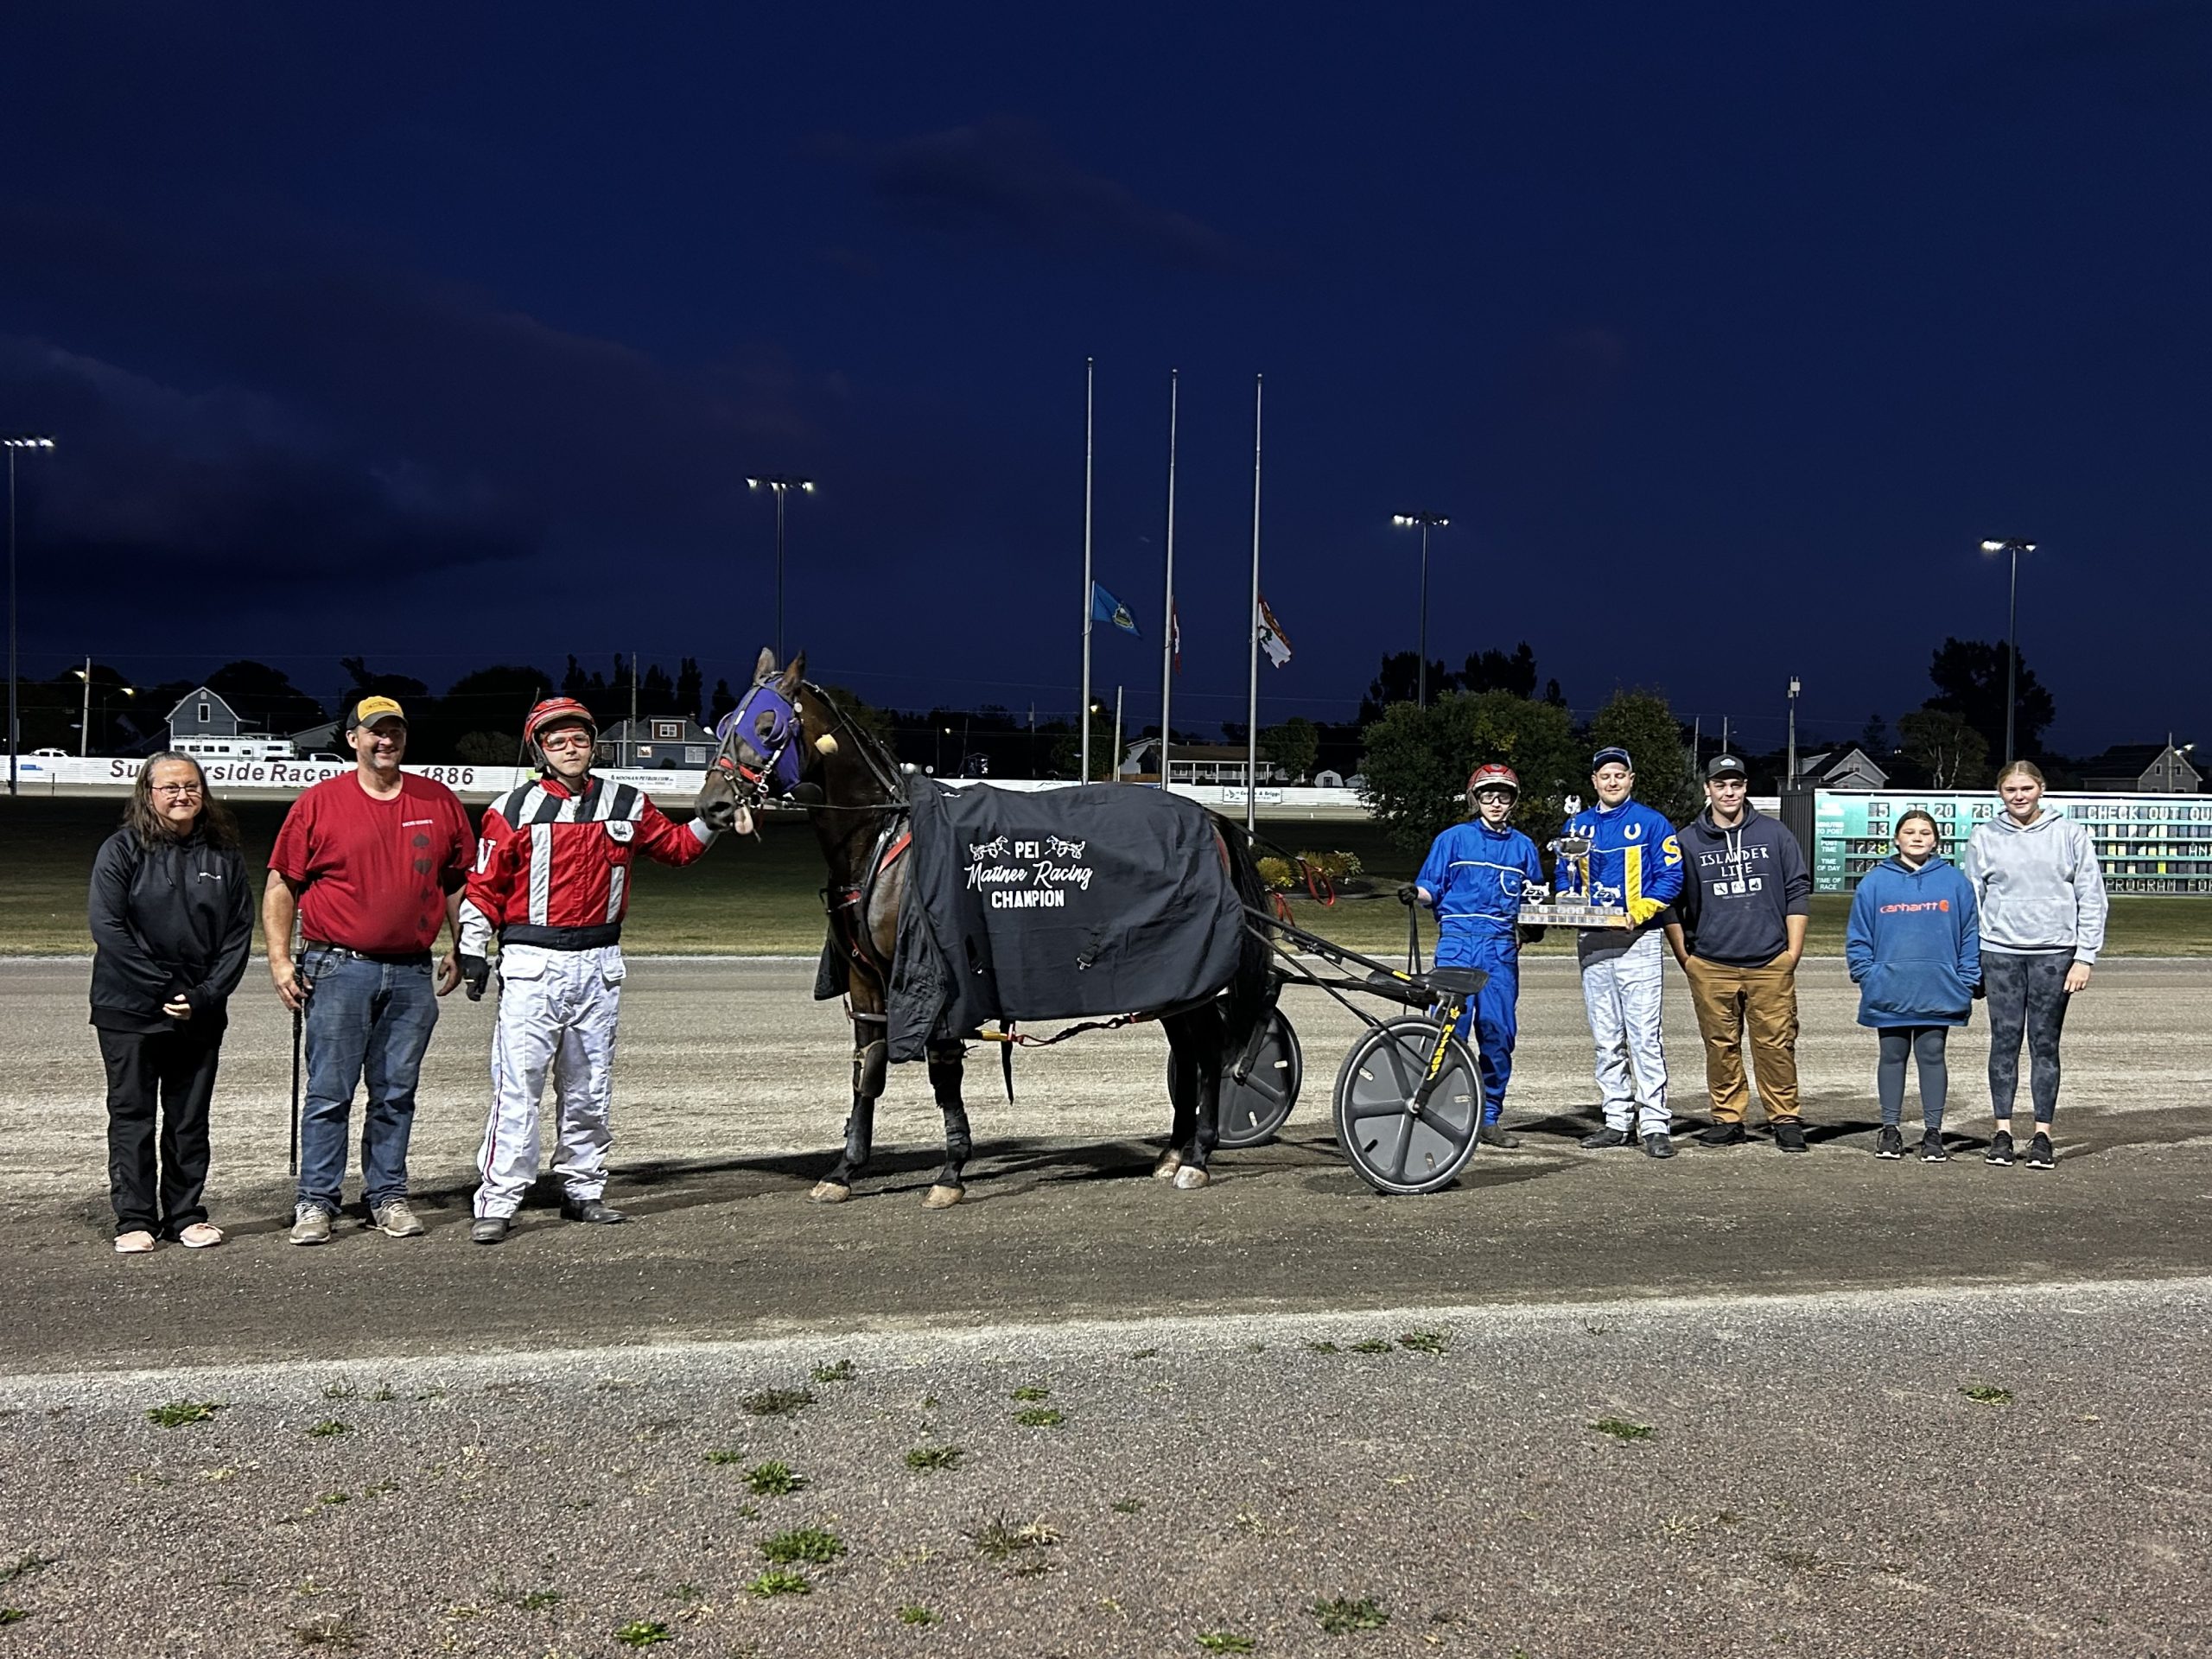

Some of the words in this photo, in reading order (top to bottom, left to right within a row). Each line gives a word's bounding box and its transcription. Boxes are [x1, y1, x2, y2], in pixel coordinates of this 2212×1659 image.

[110, 760, 264, 781] Surside
[1878, 803, 1888, 818] 5
[1936, 804, 1954, 818] 20
[1973, 804, 1992, 818] 78
[2088, 806, 2139, 820] CHECK
[2149, 806, 2179, 820] OUT
[2190, 807, 2212, 821] OU
[1878, 822, 1888, 836] 3
[1014, 841, 1040, 859] PEI
[1700, 847, 1770, 867] ISLANDER
[964, 862, 1028, 892] Matinee
[1033, 861, 1093, 891] Racing
[1721, 862, 1753, 877] LIFE
[2106, 878, 2177, 892] PROGRAM
[991, 889, 1065, 908] CHAMPION
[1879, 902, 1938, 913] carhartt
